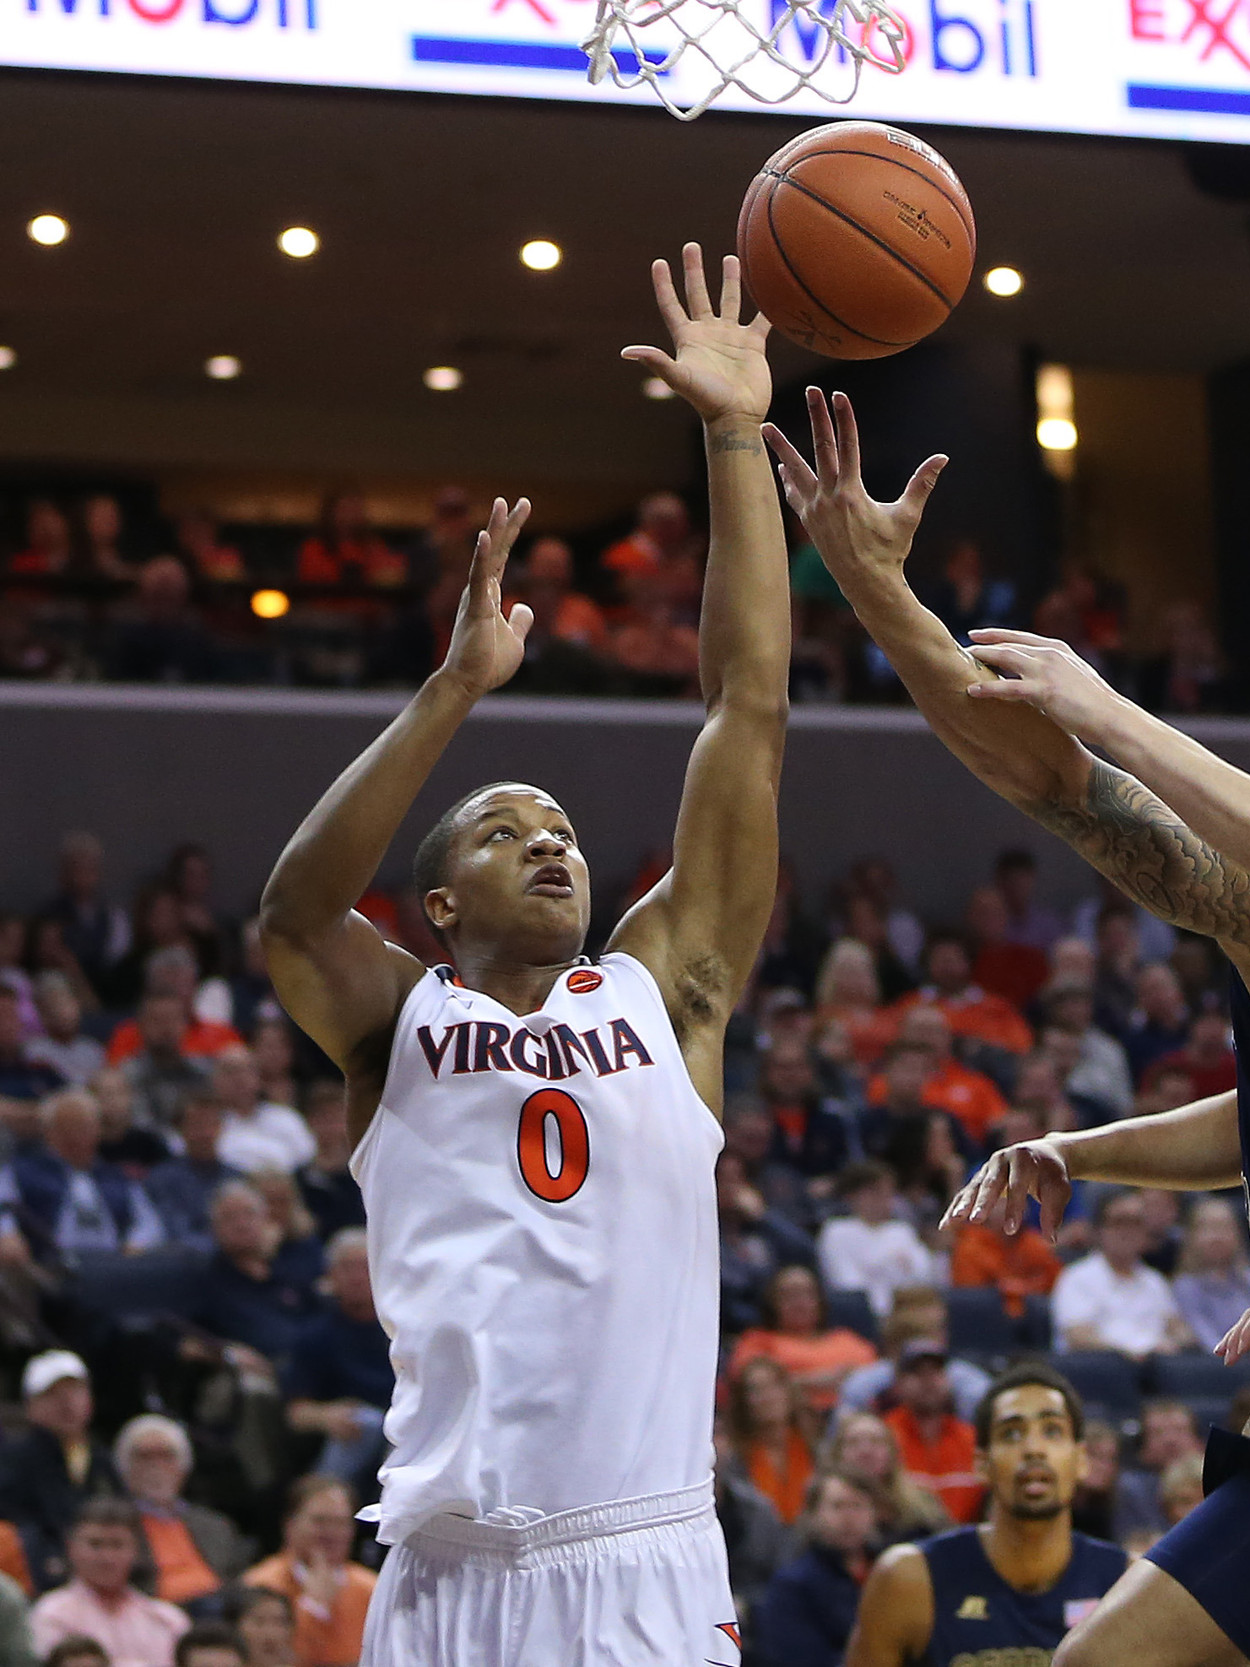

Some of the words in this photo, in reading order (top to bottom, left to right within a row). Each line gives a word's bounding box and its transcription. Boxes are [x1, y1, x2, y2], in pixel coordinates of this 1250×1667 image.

[767, 0, 1037, 77] Mobil
[416, 1017, 655, 1081] VIRGINIA
[516, 1087, 591, 1204] 0
